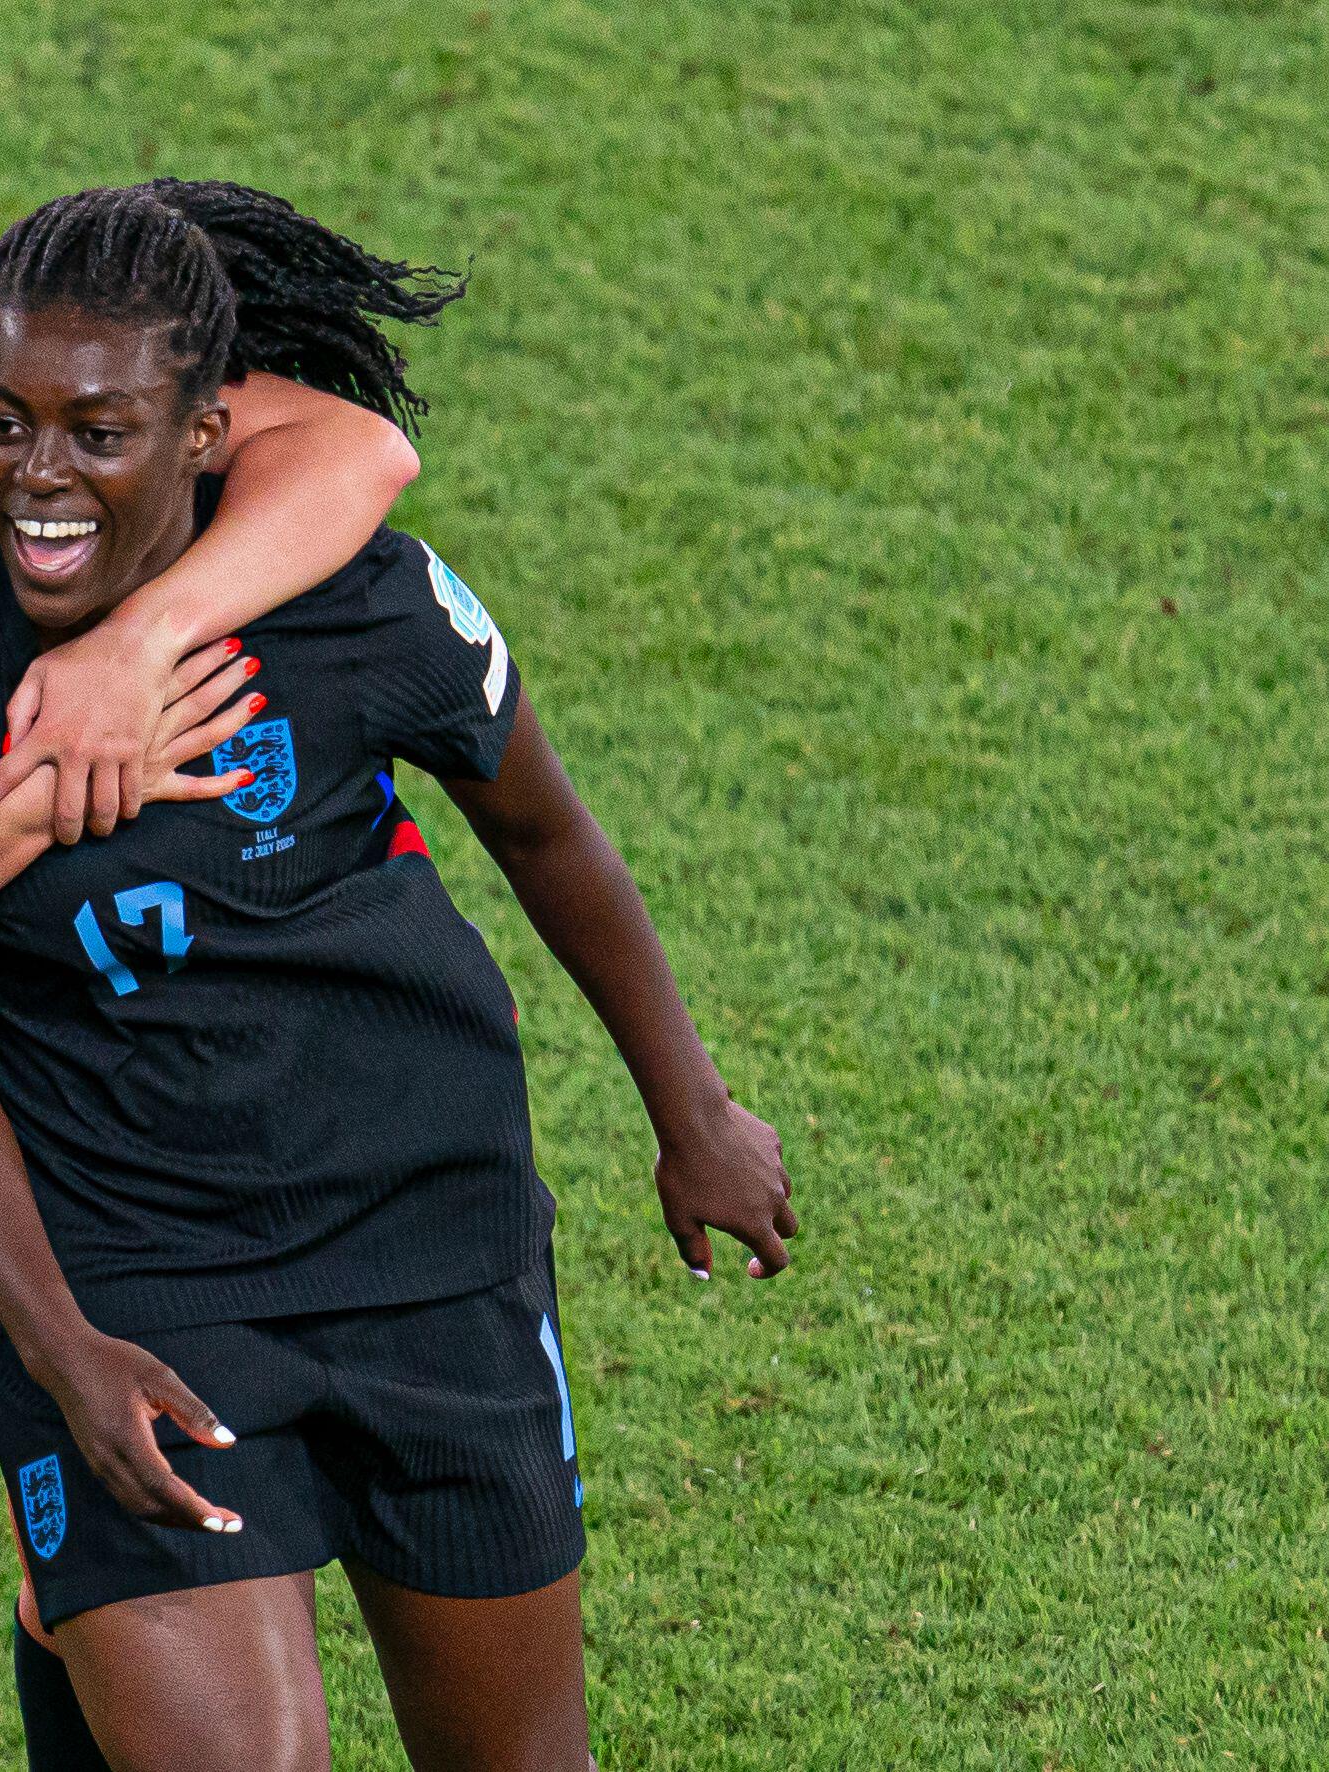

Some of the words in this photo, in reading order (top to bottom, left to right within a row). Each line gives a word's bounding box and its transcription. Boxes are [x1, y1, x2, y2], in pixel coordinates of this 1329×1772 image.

[242, 847, 253, 861] 22
[255, 842, 274, 857] JULY
[276, 834, 296, 852] 2025
[256, 826, 278, 843] ITALY
[74, 881, 195, 997] 17
